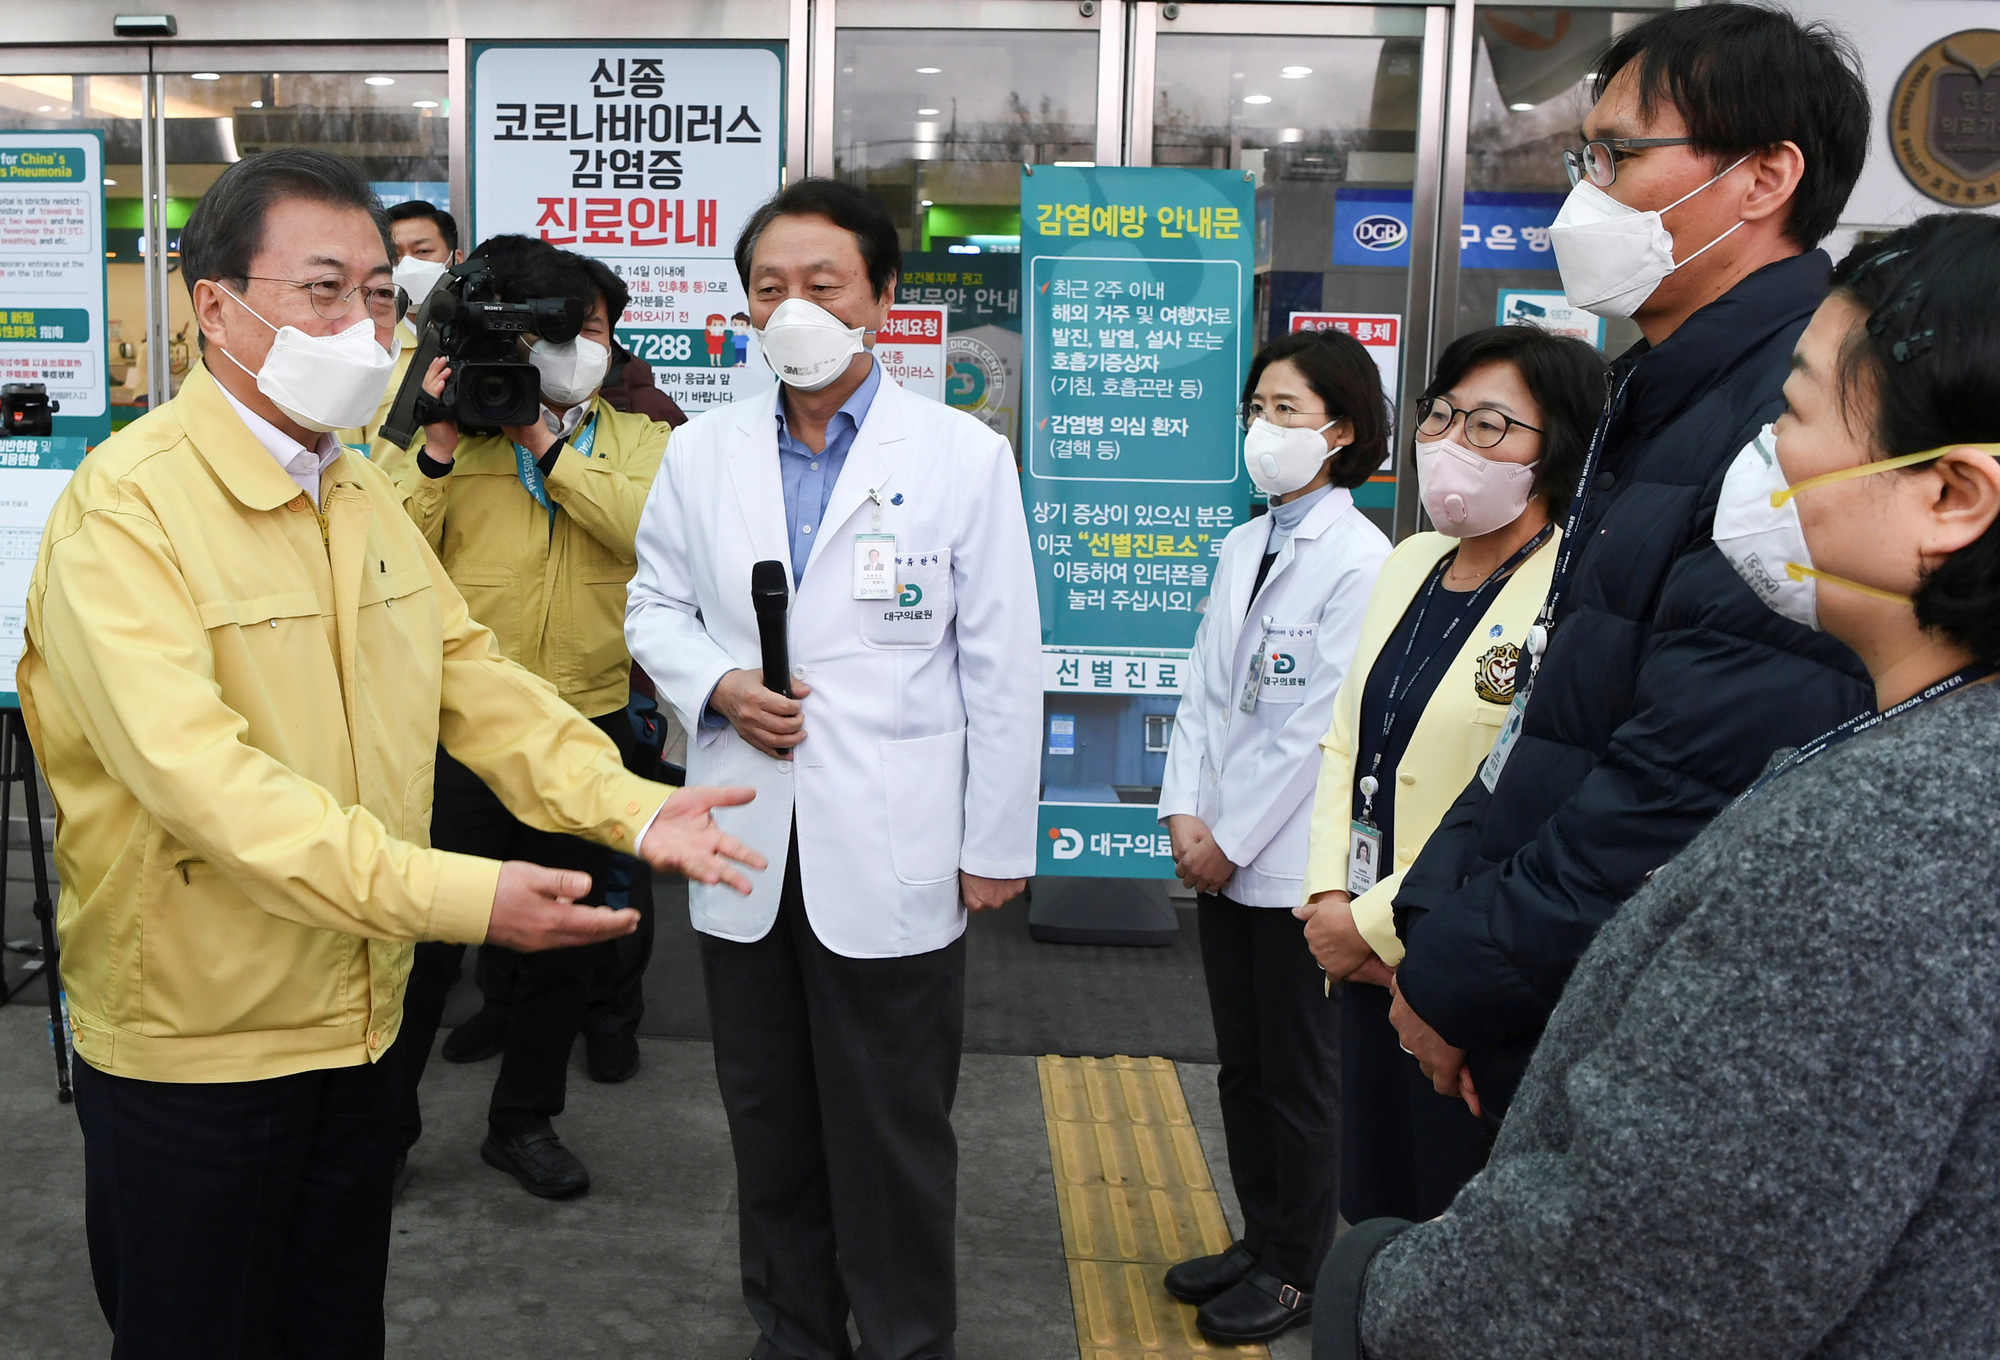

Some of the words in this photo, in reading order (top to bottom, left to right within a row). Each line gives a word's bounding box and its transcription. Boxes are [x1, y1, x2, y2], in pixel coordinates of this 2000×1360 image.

[590, 58, 665, 98] 신종
[494, 103, 761, 144] 코로나바이러스
[1941, 118, 2000, 134] 의료기
[0, 153, 18, 165] for
[570, 149, 683, 190] 감염증
[10, 166, 73, 178] Pneumonia
[25, 198, 51, 206] strictly
[536, 197, 716, 247] 진료안내
[1036, 203, 1147, 239] 감염예방
[1157, 206, 1241, 240] 안내문
[1359, 223, 1400, 241] DGB
[628, 266, 650, 277] 14일
[654, 266, 685, 278] 이내에
[903, 272, 957, 284] 보건복지부
[658, 281, 689, 292] 인후통
[693, 281, 728, 293] 등)으로
[1053, 279, 1089, 299] 최근
[1094, 281, 1123, 299] 2주
[1129, 281, 1165, 300] 이내
[974, 288, 1018, 315] 안내
[623, 311, 674, 323] 들어오시기
[678, 311, 689, 323] 전
[1052, 303, 1088, 323] 해외
[1094, 304, 1131, 324] 거주
[1136, 305, 1154, 326] 및
[1159, 306, 1232, 327] 여행자로
[880, 318, 938, 337] 자제요청
[1052, 327, 1093, 349] 발진,
[1099, 329, 1140, 350] 발열,
[1145, 330, 1182, 350] 설사
[1187, 331, 1224, 351] 또는
[1356, 322, 1391, 341] 통제
[880, 351, 905, 364] 신종
[1051, 351, 1160, 374] 호흡기증상자
[660, 373, 681, 385] 받아
[685, 373, 716, 385] 응급실
[720, 373, 730, 385] 앞
[783, 365, 799, 376] 3M
[981, 350, 1003, 390] CENTER
[691, 391, 736, 404] 바랍니다.
[1050, 375, 1096, 397] (기침,
[1101, 377, 1174, 398] 호흡곤란
[1178, 379, 1204, 400] 등)
[1051, 415, 1104, 436] 감염병
[1110, 416, 1146, 437] 의심
[1151, 417, 1189, 438] 환자
[41, 440, 52, 453] 및
[1050, 438, 1091, 459] (결핵
[1096, 439, 1121, 461] 등)
[1575, 477, 1586, 498] DAEGU
[1582, 451, 1593, 478] MEDICAL
[1589, 427, 1600, 451] CENTER
[1033, 501, 1067, 525] 상기
[1072, 503, 1128, 526] 증상이
[1134, 505, 1190, 527] 있으신
[1195, 506, 1234, 528] 분은
[1037, 534, 1073, 556] 이곳
[1053, 561, 1128, 584] 이동하여
[1133, 563, 1210, 587] 인터폰을
[1747, 558, 1776, 592] N95
[1067, 588, 1105, 610] 눌러
[1110, 589, 1192, 612] 주십시오!
[884, 609, 933, 622] 대구의료원
[1056, 659, 1179, 688] 선별진료
[1264, 676, 1306, 687] 대구의료원
[1853, 714, 1883, 733] DAEGU
[1884, 696, 1924, 718] MEDICAL
[1924, 675, 1963, 699] CENTER
[1801, 729, 1837, 751] MEDICAL
[1837, 710, 1872, 731] CENTER
[1090, 832, 1173, 858] 대구의료
